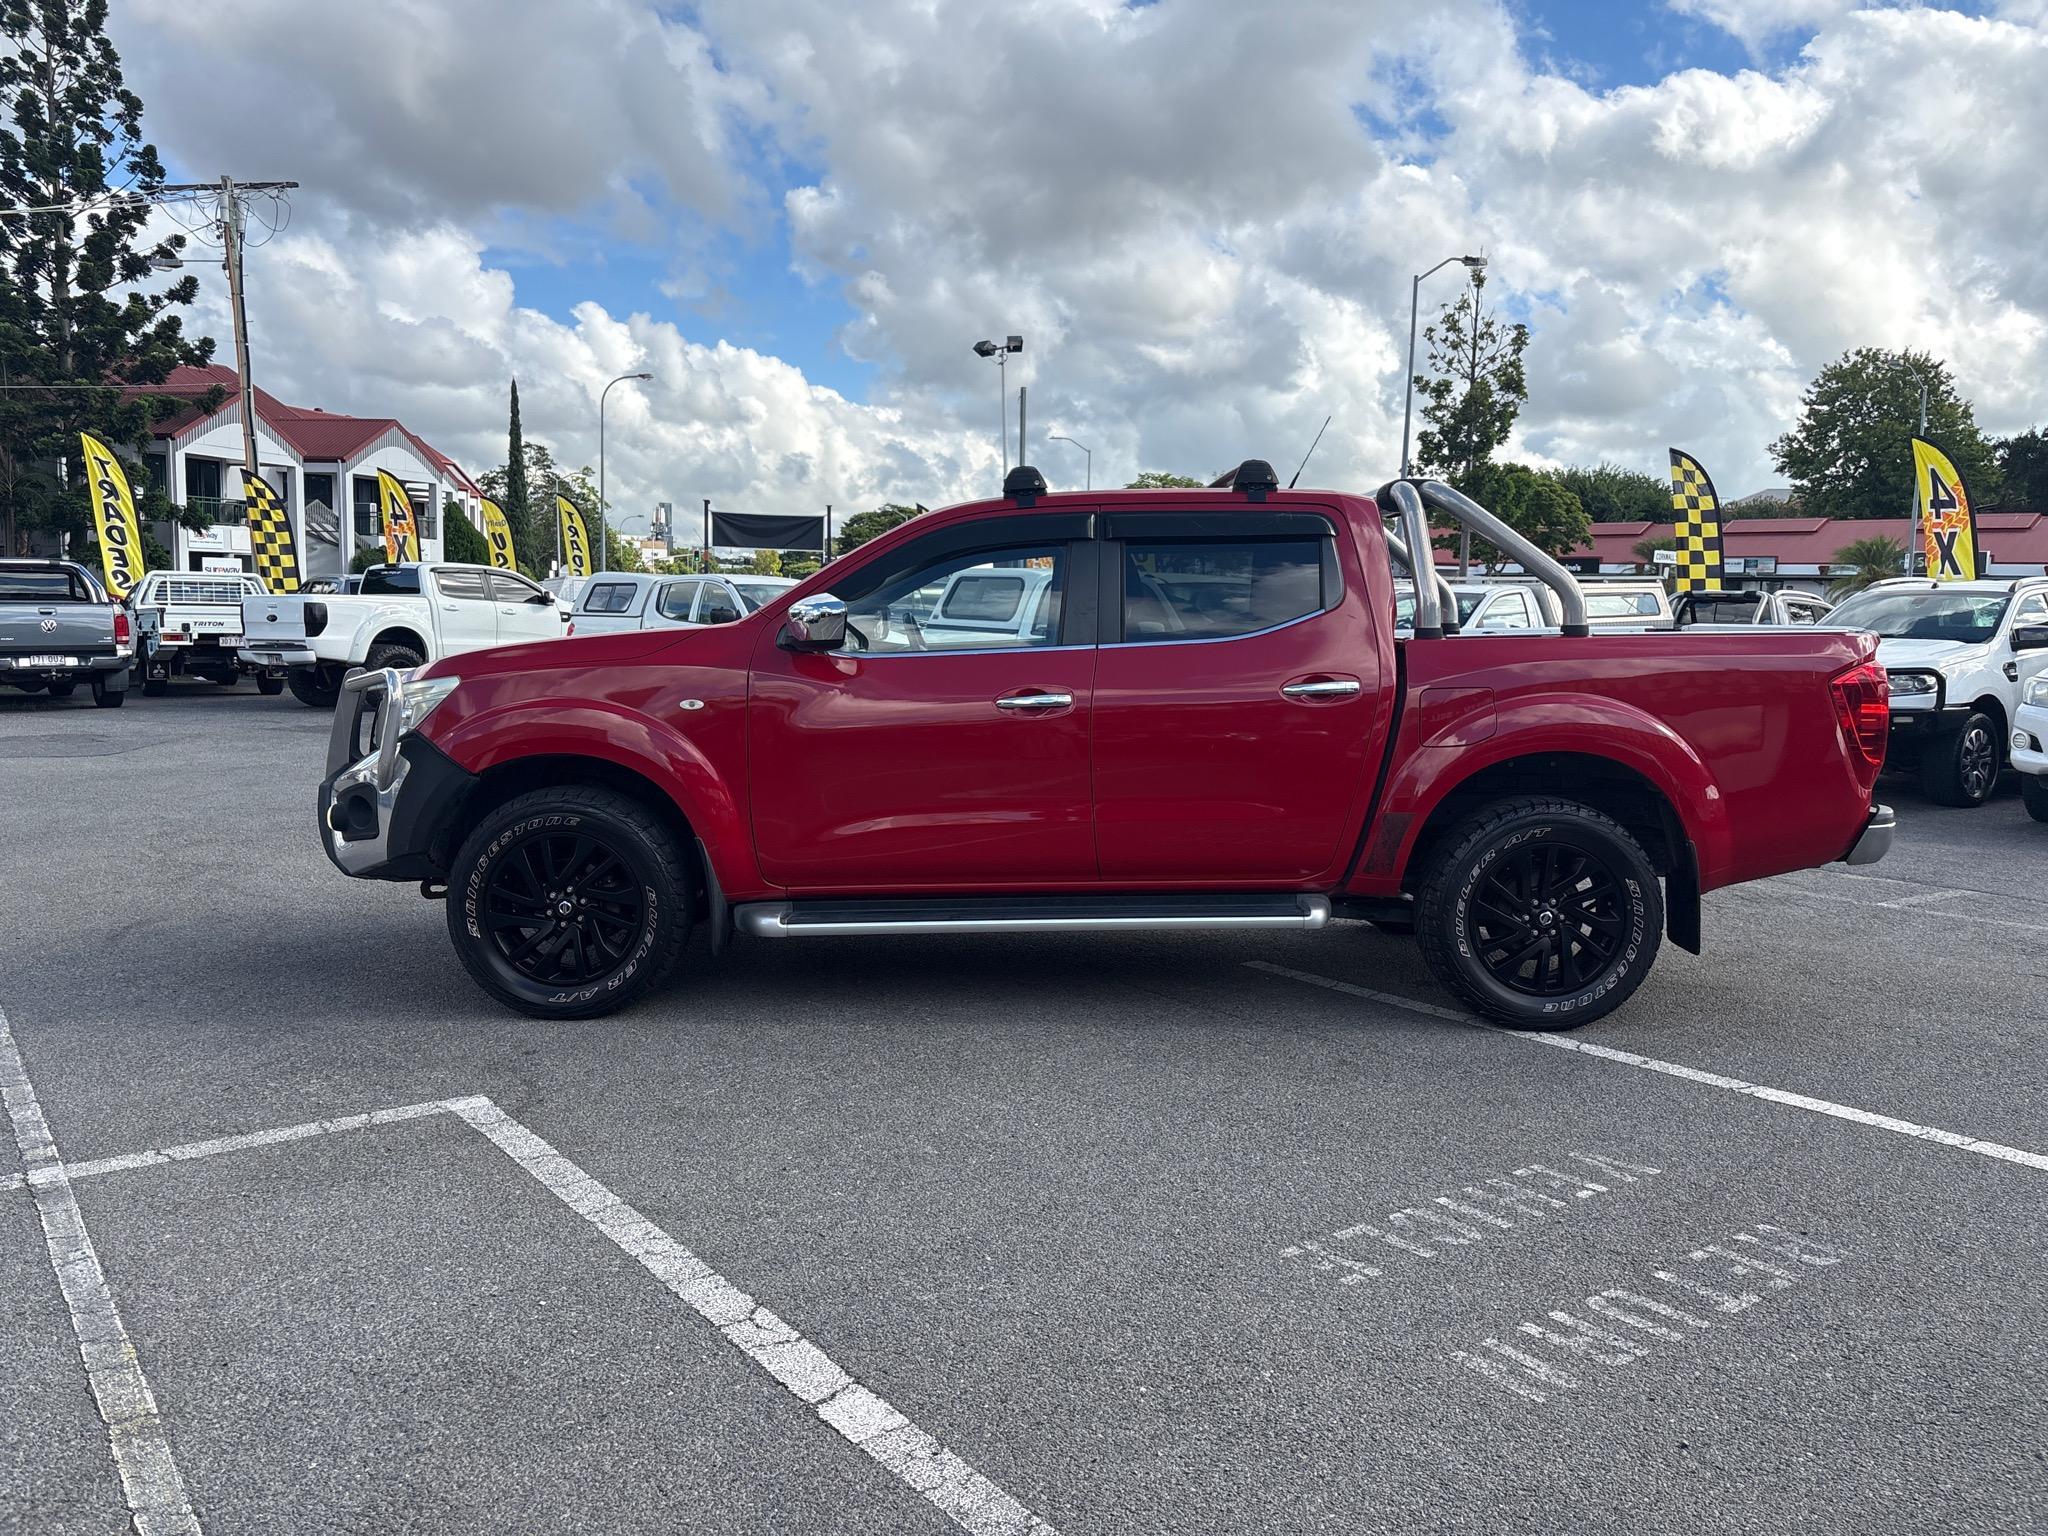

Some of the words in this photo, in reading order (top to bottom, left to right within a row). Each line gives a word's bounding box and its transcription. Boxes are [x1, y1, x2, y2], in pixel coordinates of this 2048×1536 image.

[465, 816, 582, 939] BRIDGESTONE
[608, 886, 659, 990] DUELER
[1455, 849, 1496, 958] DUELER
[1504, 827, 1551, 850] A/T
[549, 987, 599, 1003] A/T
[1542, 878, 1644, 1013] BRIDGESTONE
[1280, 1151, 1663, 1286] VEHICLE
[1449, 1224, 1850, 1402] RETURN
